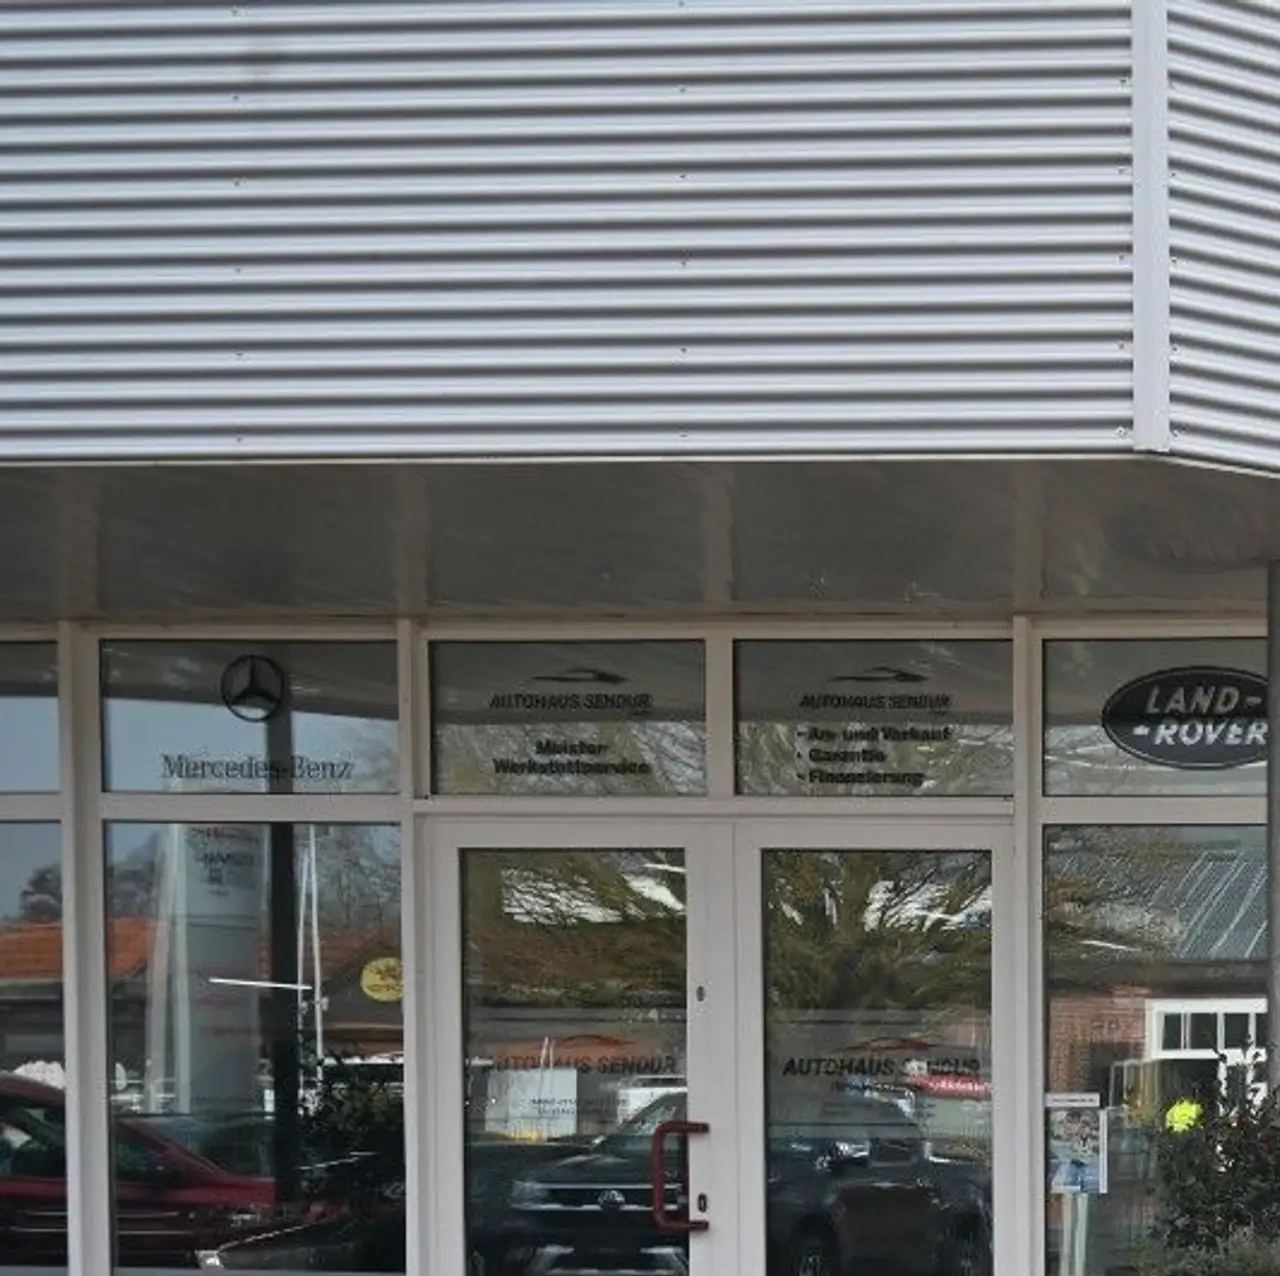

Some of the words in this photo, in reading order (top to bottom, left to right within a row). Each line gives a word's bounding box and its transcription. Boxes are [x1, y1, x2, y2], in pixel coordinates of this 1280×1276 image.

[489, 693, 580, 710] AUTOHAUS
[583, 693, 654, 710] SENDUR
[160, 753, 355, 780] Mercedes-Benz
[783, 1056, 896, 1077] AUTOHAUS
